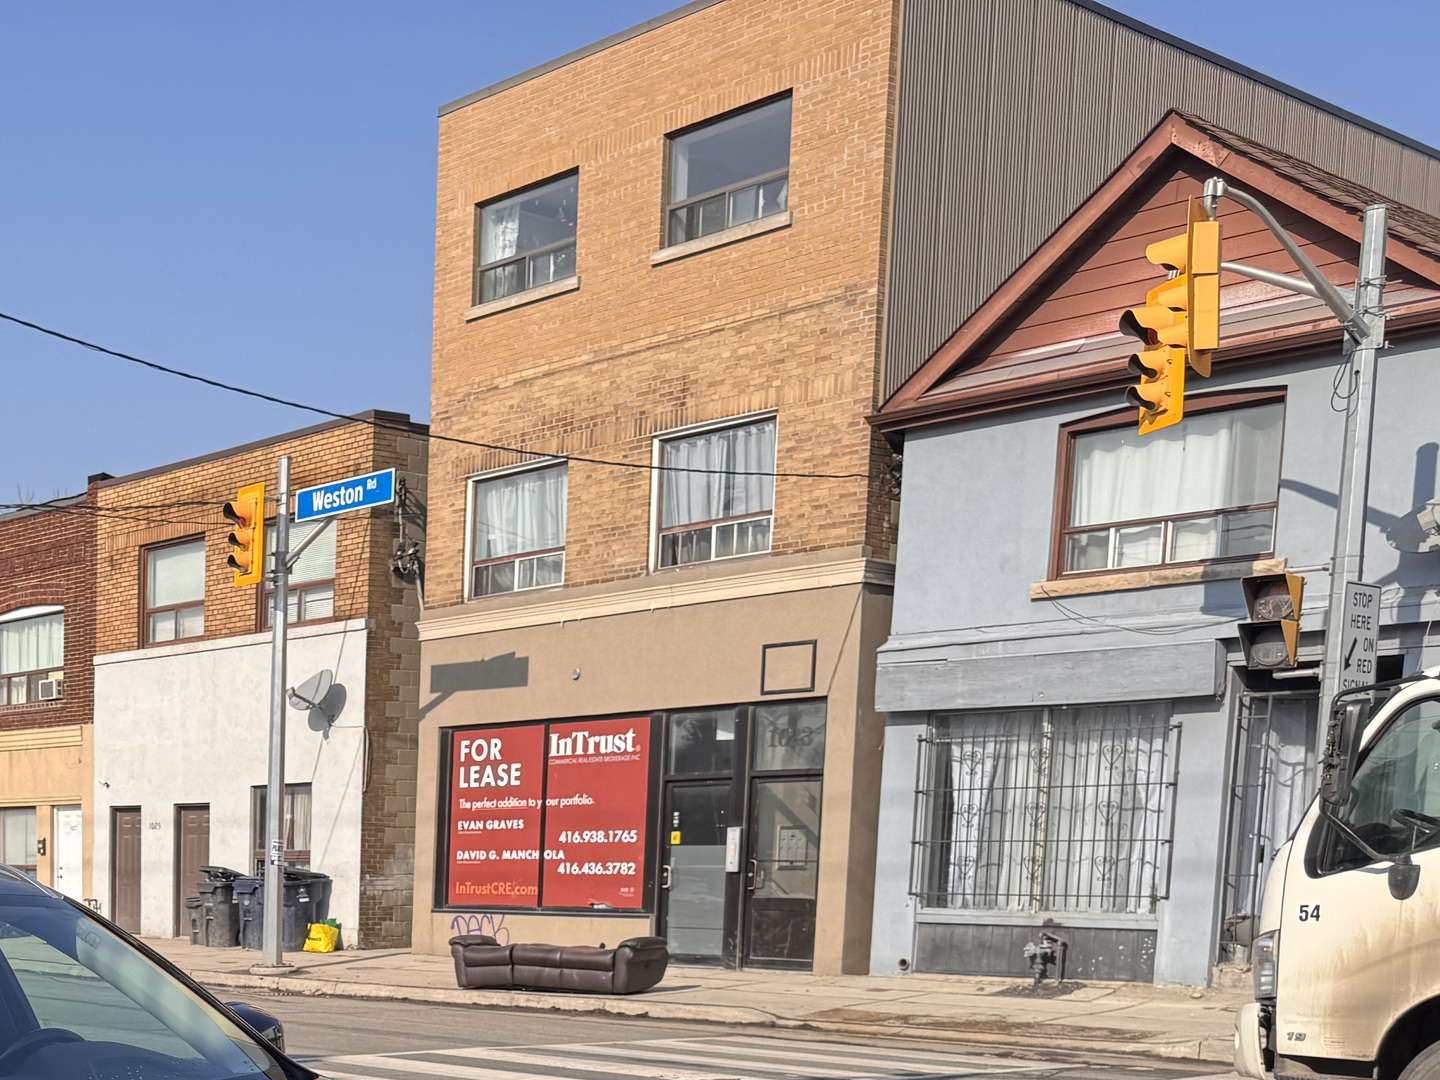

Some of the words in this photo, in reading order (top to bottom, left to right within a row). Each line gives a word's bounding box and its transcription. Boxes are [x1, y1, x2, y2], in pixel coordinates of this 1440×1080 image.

[312, 485, 364, 512] Weston
[366, 477, 377, 490] Rd
[1353, 591, 1373, 608] STOP
[1350, 613, 1372, 631] HERE
[1362, 637, 1374, 653] ON
[1356, 658, 1373, 674] RED
[460, 738, 502, 762] FOR
[459, 763, 522, 788] LEASE
[459, 798, 471, 808] The
[472, 797, 497, 811] perfect
[497, 797, 527, 808] addition
[528, 798, 536, 807] to
[560, 793, 595, 808] portfolio.
[457, 821, 484, 831] EVAN
[485, 819, 524, 830] GRAVES
[558, 829, 638, 844] 416.938.1765
[456, 850, 487, 861] DAVID
[488, 850, 499, 860] G.
[557, 862, 636, 876] 416.436.3782
[455, 881, 539, 896] InTrustCRE.com
[1298, 904, 1321, 922] 54
